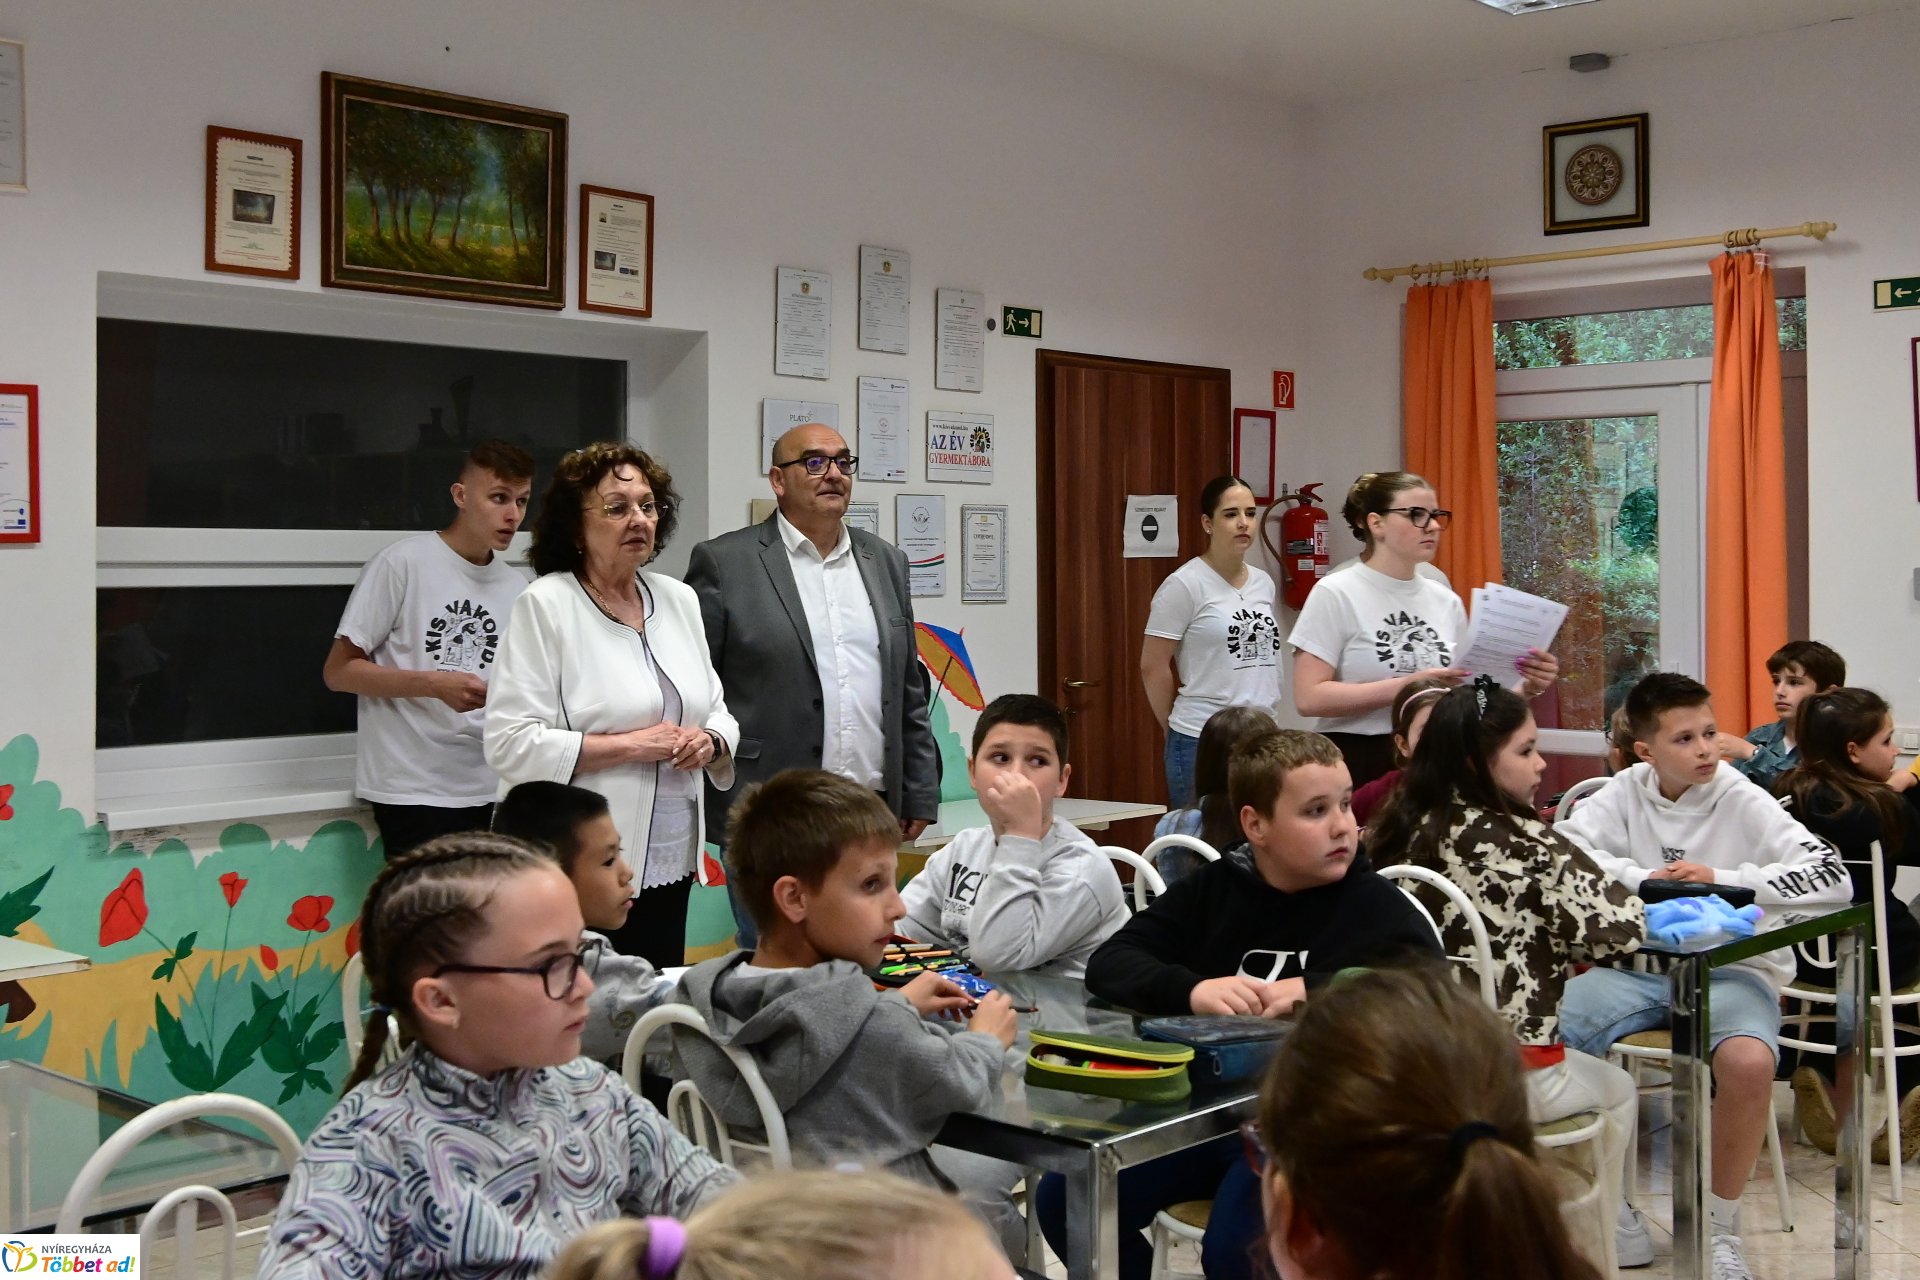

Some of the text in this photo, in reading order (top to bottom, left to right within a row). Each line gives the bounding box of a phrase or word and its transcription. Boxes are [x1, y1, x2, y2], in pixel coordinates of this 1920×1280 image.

[930, 430, 966, 451] AZ ÉV
[929, 451, 992, 467] GYERMEKTÁBORA
[425, 599, 499, 664] KIS VAKOND
[1227, 608, 1281, 655] KIS VAKOND
[1375, 629, 1395, 663] KIS
